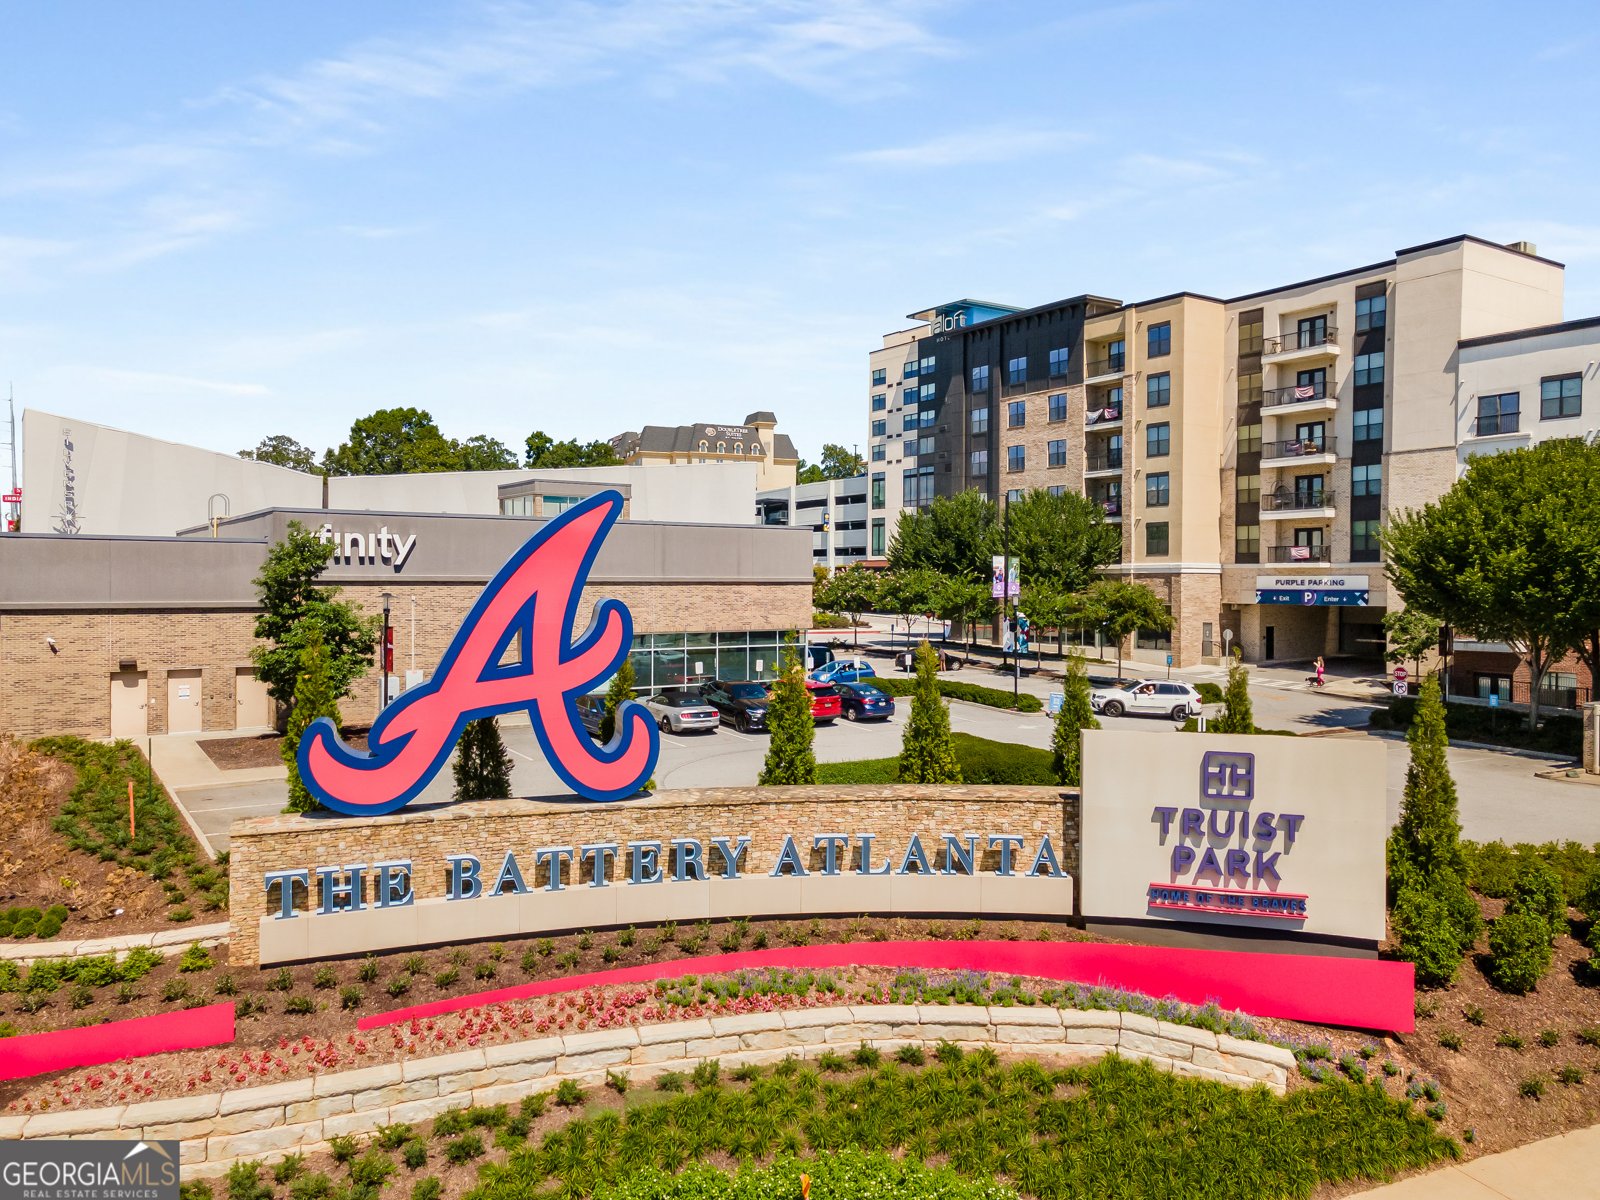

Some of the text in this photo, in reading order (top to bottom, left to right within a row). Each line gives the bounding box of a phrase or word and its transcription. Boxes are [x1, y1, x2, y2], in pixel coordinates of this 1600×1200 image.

[931, 310, 967, 334] aloft
[309, 523, 417, 565] finity
[1154, 806, 1305, 843] TRUIST
[264, 832, 1068, 920] THE BATTERY ATLANTA
[1173, 845, 1282, 881] PARK
[1149, 888, 1307, 912] HOME OF THE BRAVES
